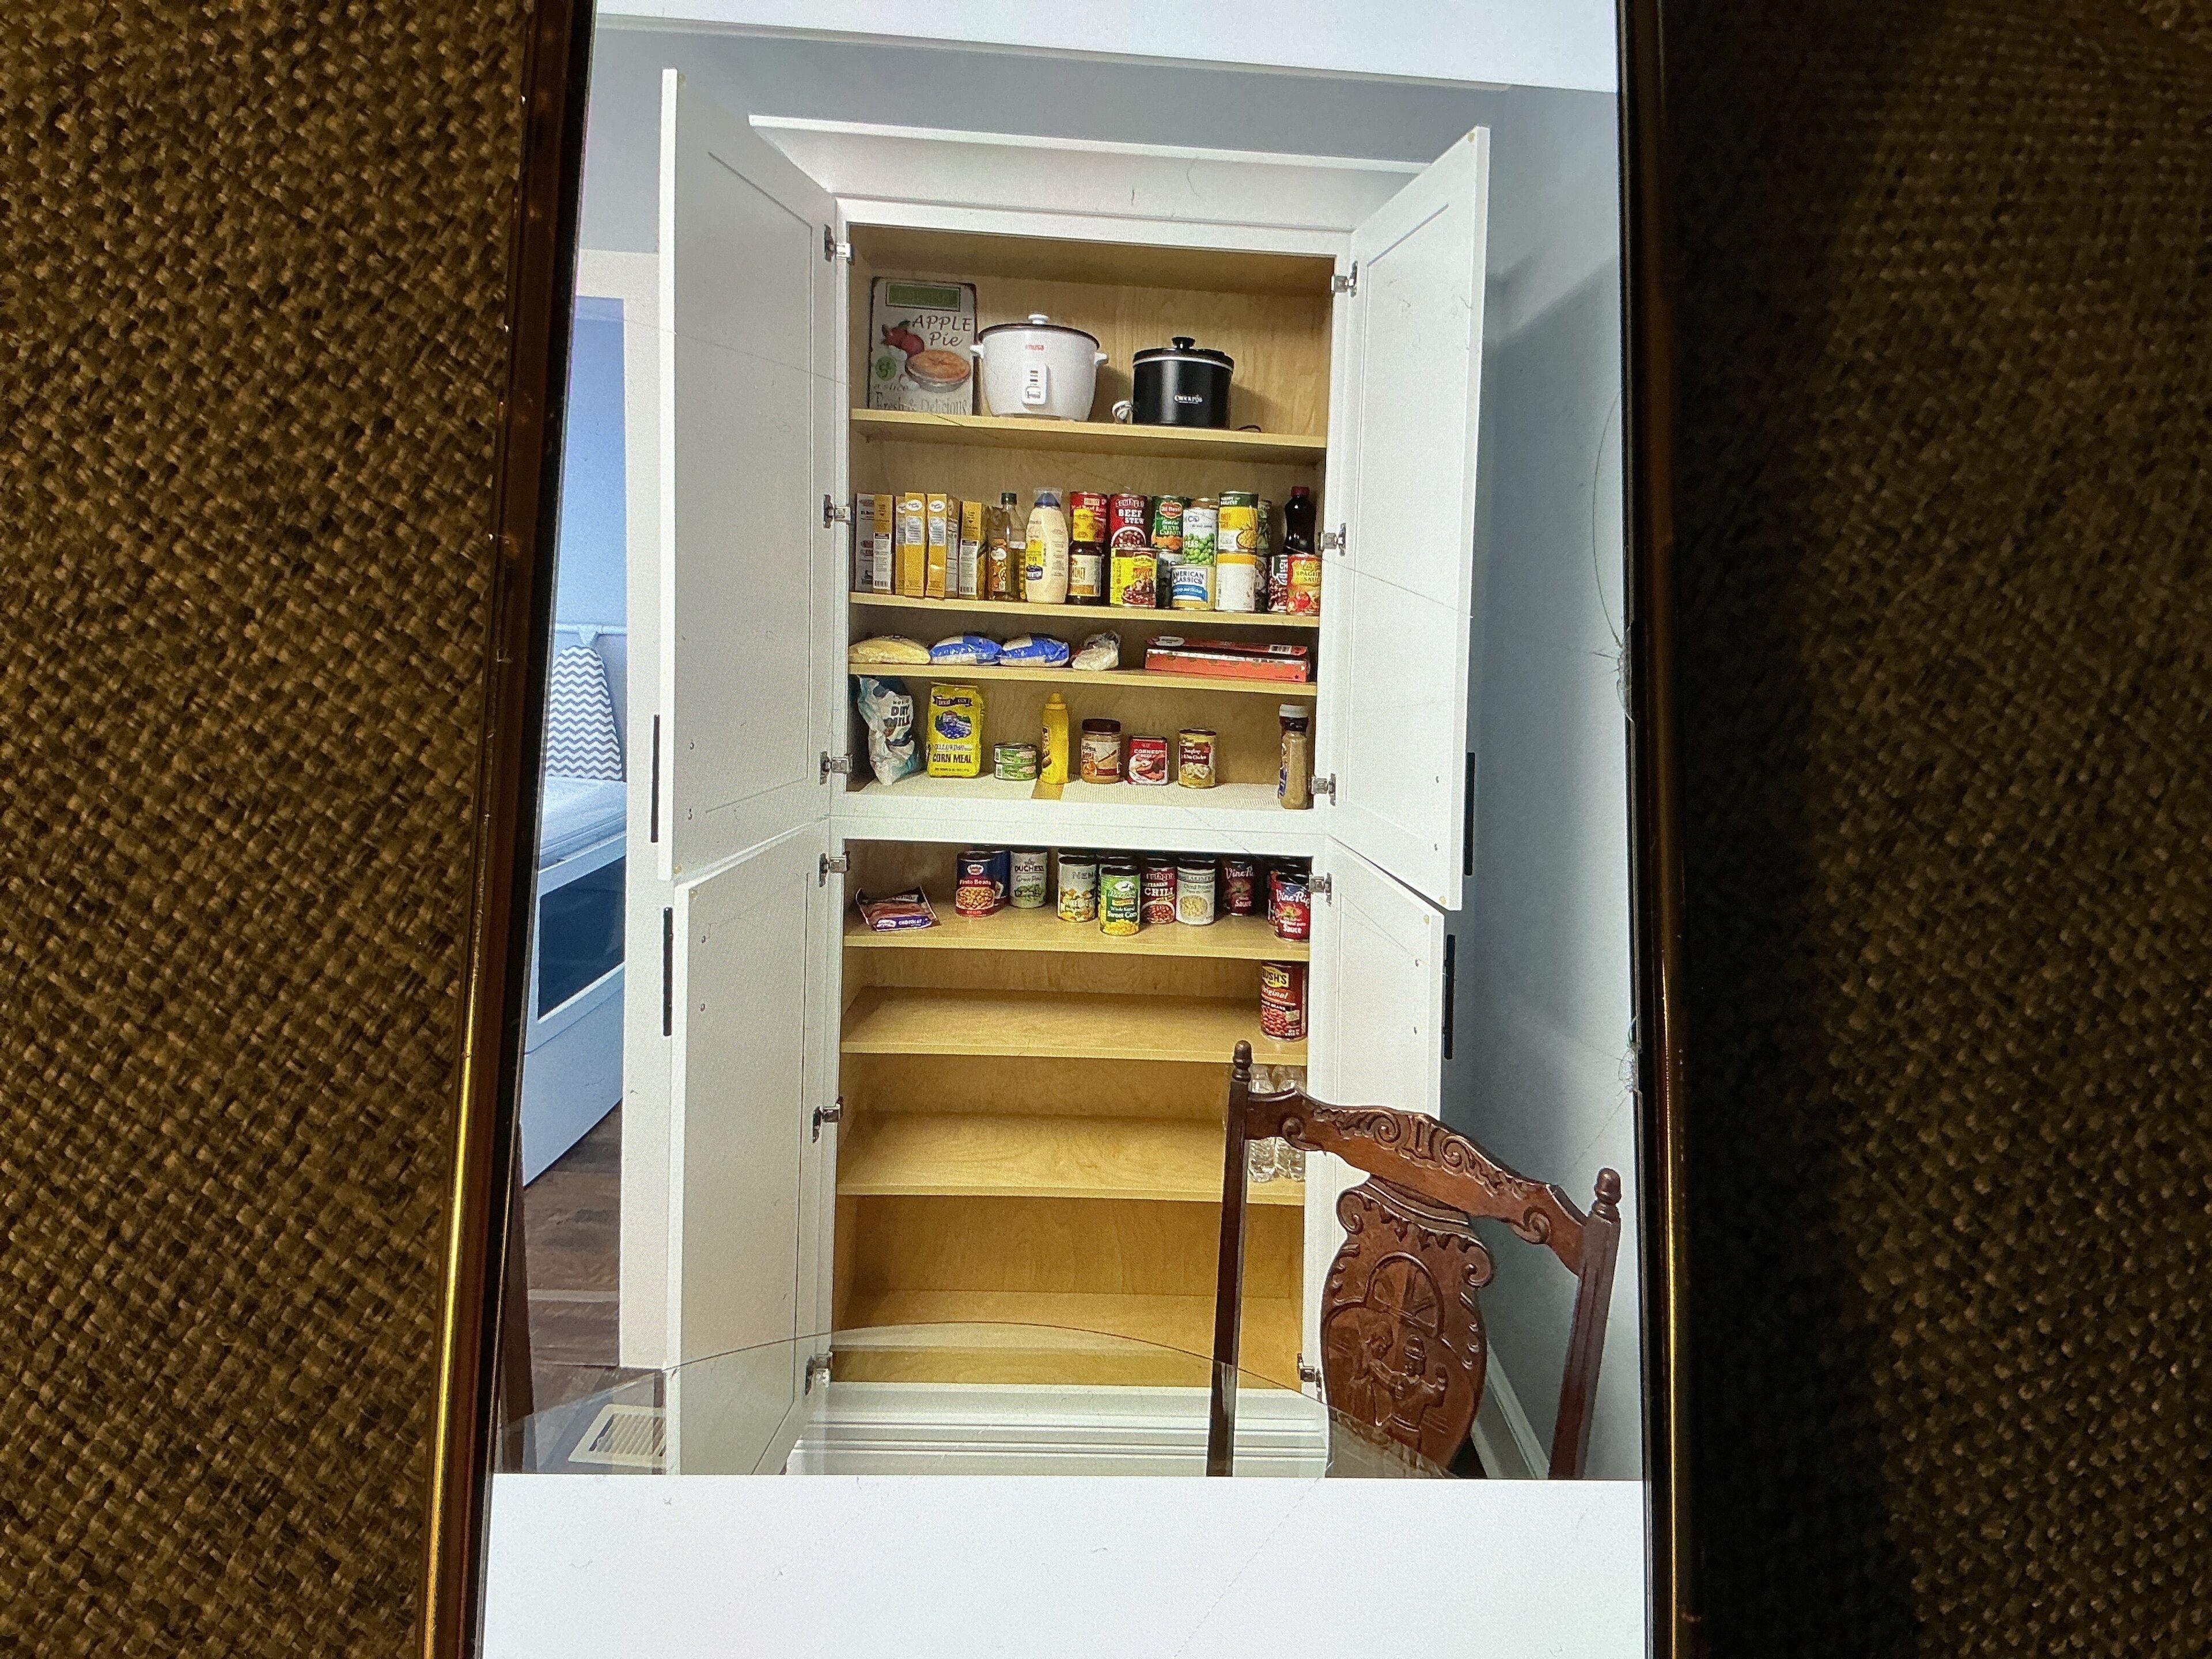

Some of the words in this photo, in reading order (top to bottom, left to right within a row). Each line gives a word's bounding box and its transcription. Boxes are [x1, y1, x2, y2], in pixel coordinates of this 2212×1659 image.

[912, 315, 973, 332] APPLE
[929, 331, 963, 347] Pie
[1118, 509, 1142, 517] BEEF
[1172, 570, 1205, 579] AMERICAN
[1172, 576, 1203, 585] CLASSICS
[891, 704, 910, 716] DRY
[933, 753, 952, 763] CORN
[953, 754, 972, 763] MEAL
[1225, 866, 1245, 880] Vine
[1144, 887, 1173, 897] CHILI
[1276, 888, 1295, 903] Vine
[1283, 923, 1302, 934] Sauce
